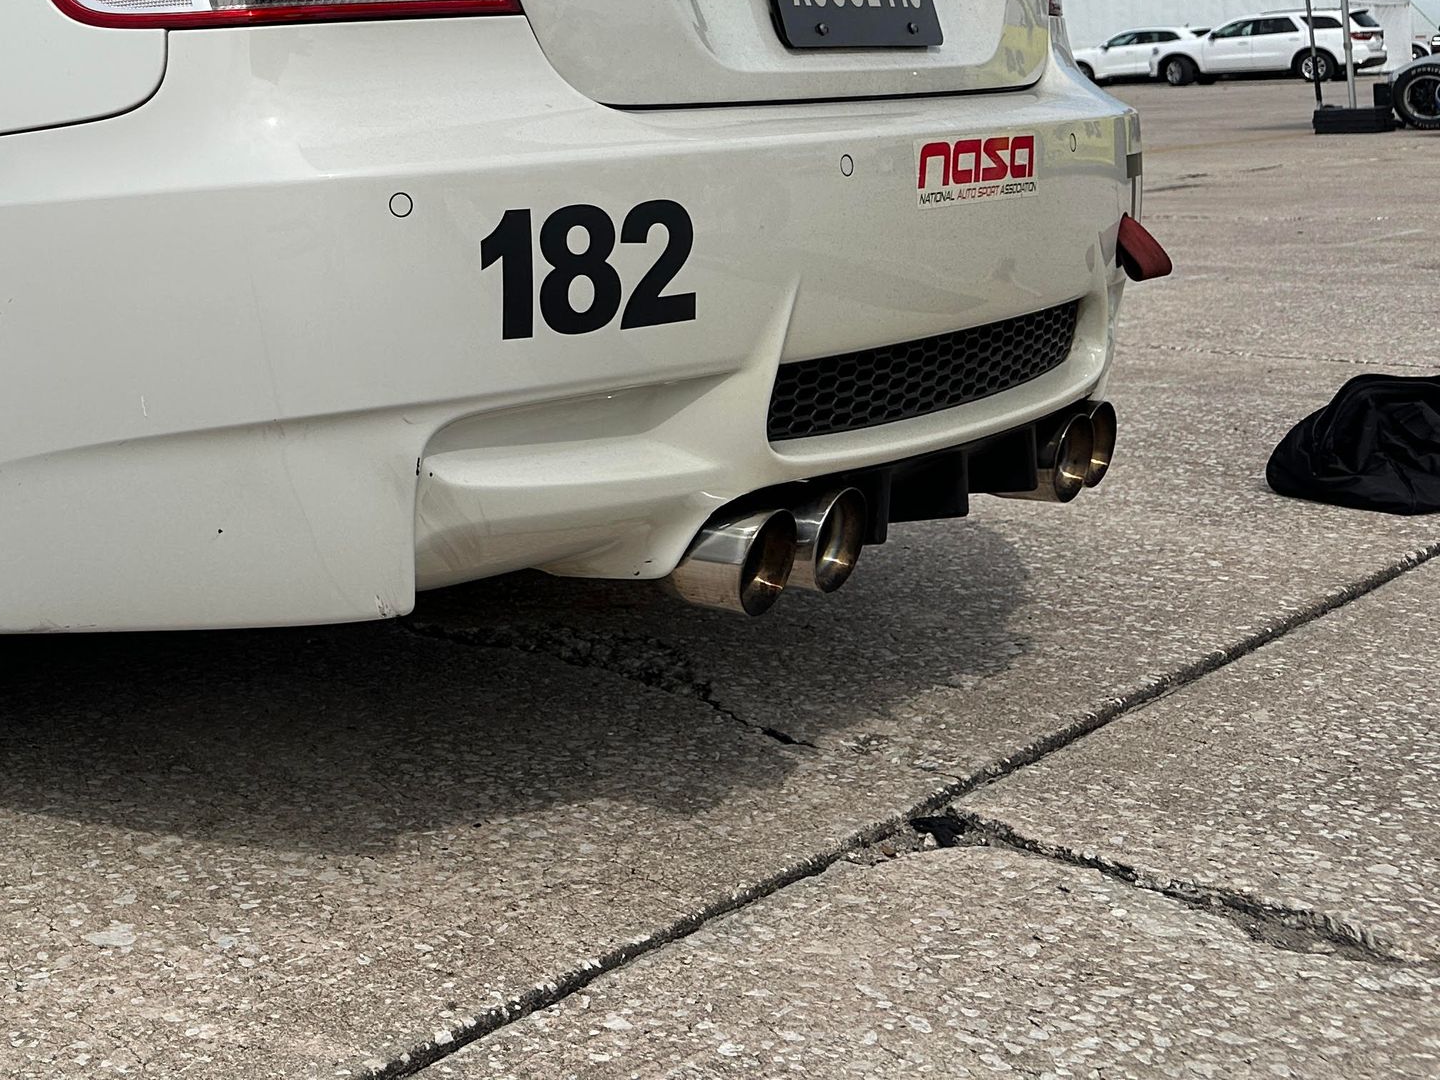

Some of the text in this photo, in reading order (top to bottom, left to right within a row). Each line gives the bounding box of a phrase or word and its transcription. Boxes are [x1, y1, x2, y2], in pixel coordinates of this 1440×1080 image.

[919, 181, 1037, 205] NATIONAL AUTO SPORT ASSOCIATION
[480, 199, 697, 340] 182
